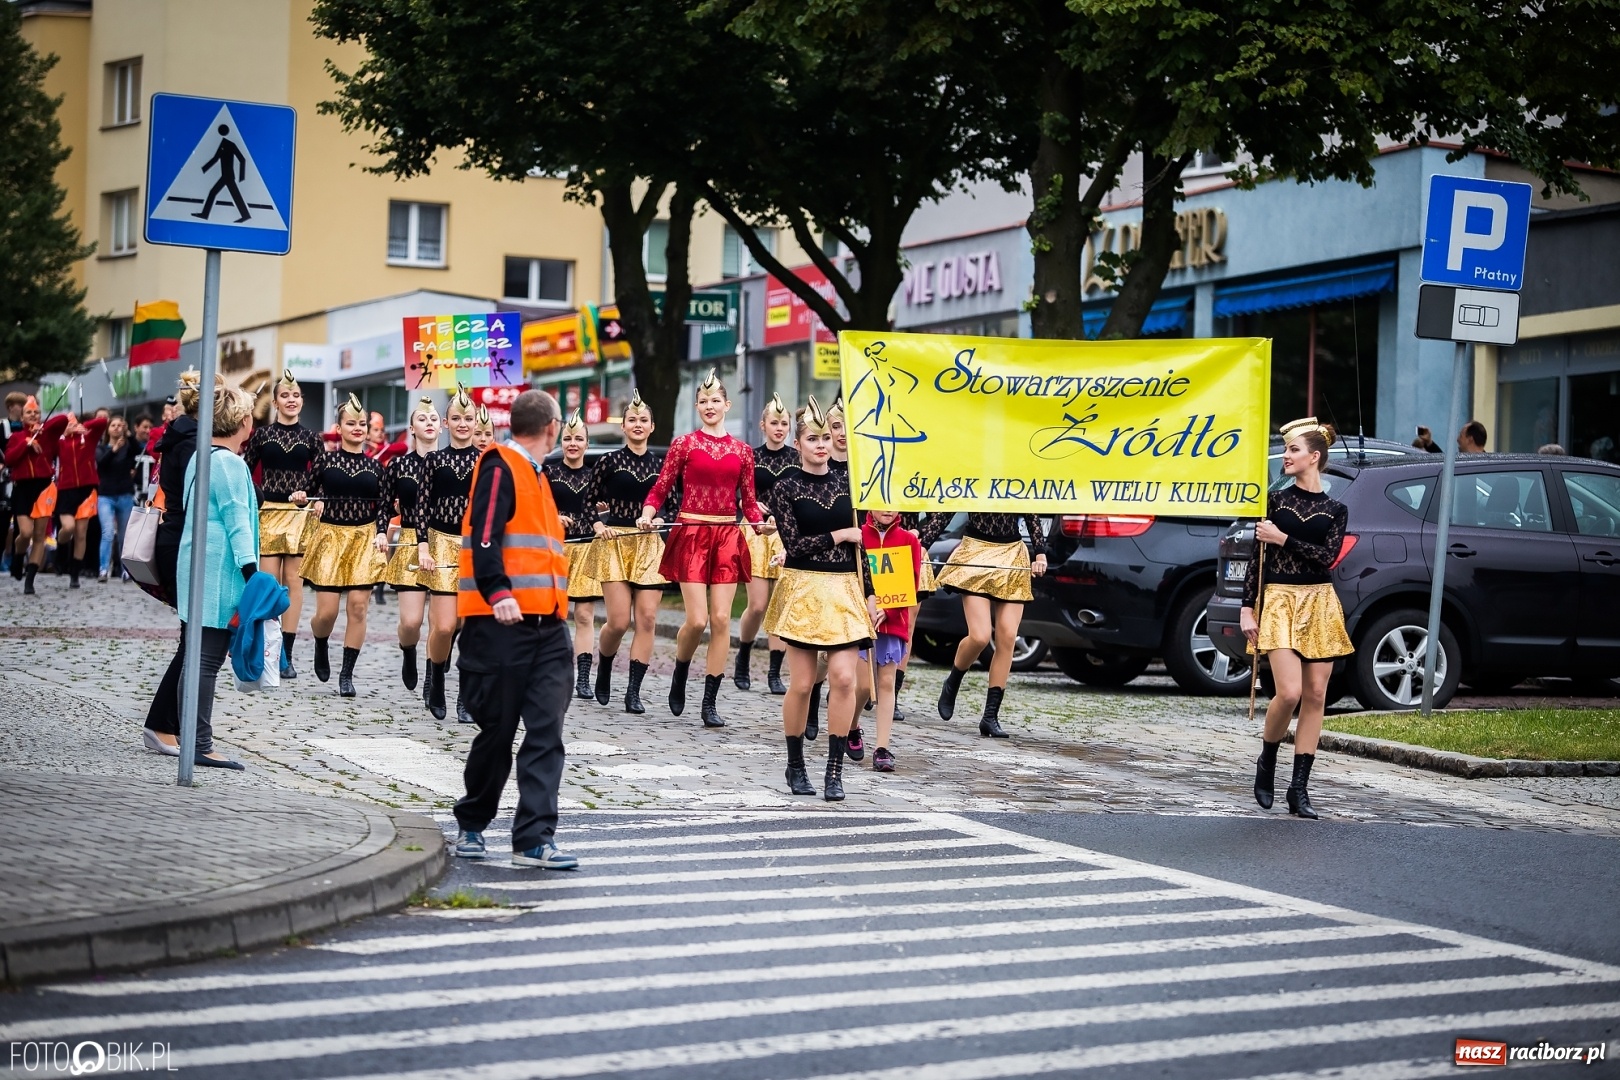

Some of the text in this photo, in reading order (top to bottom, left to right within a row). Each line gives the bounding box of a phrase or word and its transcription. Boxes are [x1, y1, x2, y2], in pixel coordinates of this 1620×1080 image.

[1446, 189, 1508, 271] P
[939, 251, 1003, 301] GUSTA
[1474, 266, 1518, 286] Płatny
[418, 318, 506, 336] TĘCZA
[434, 357, 493, 370] POLSKA
[934, 348, 1191, 408] Stowarzyszenie
[1029, 403, 1243, 460] Źródło
[903, 471, 1261, 504] ŚLĄSK KRAINA WIELU KULTUR
